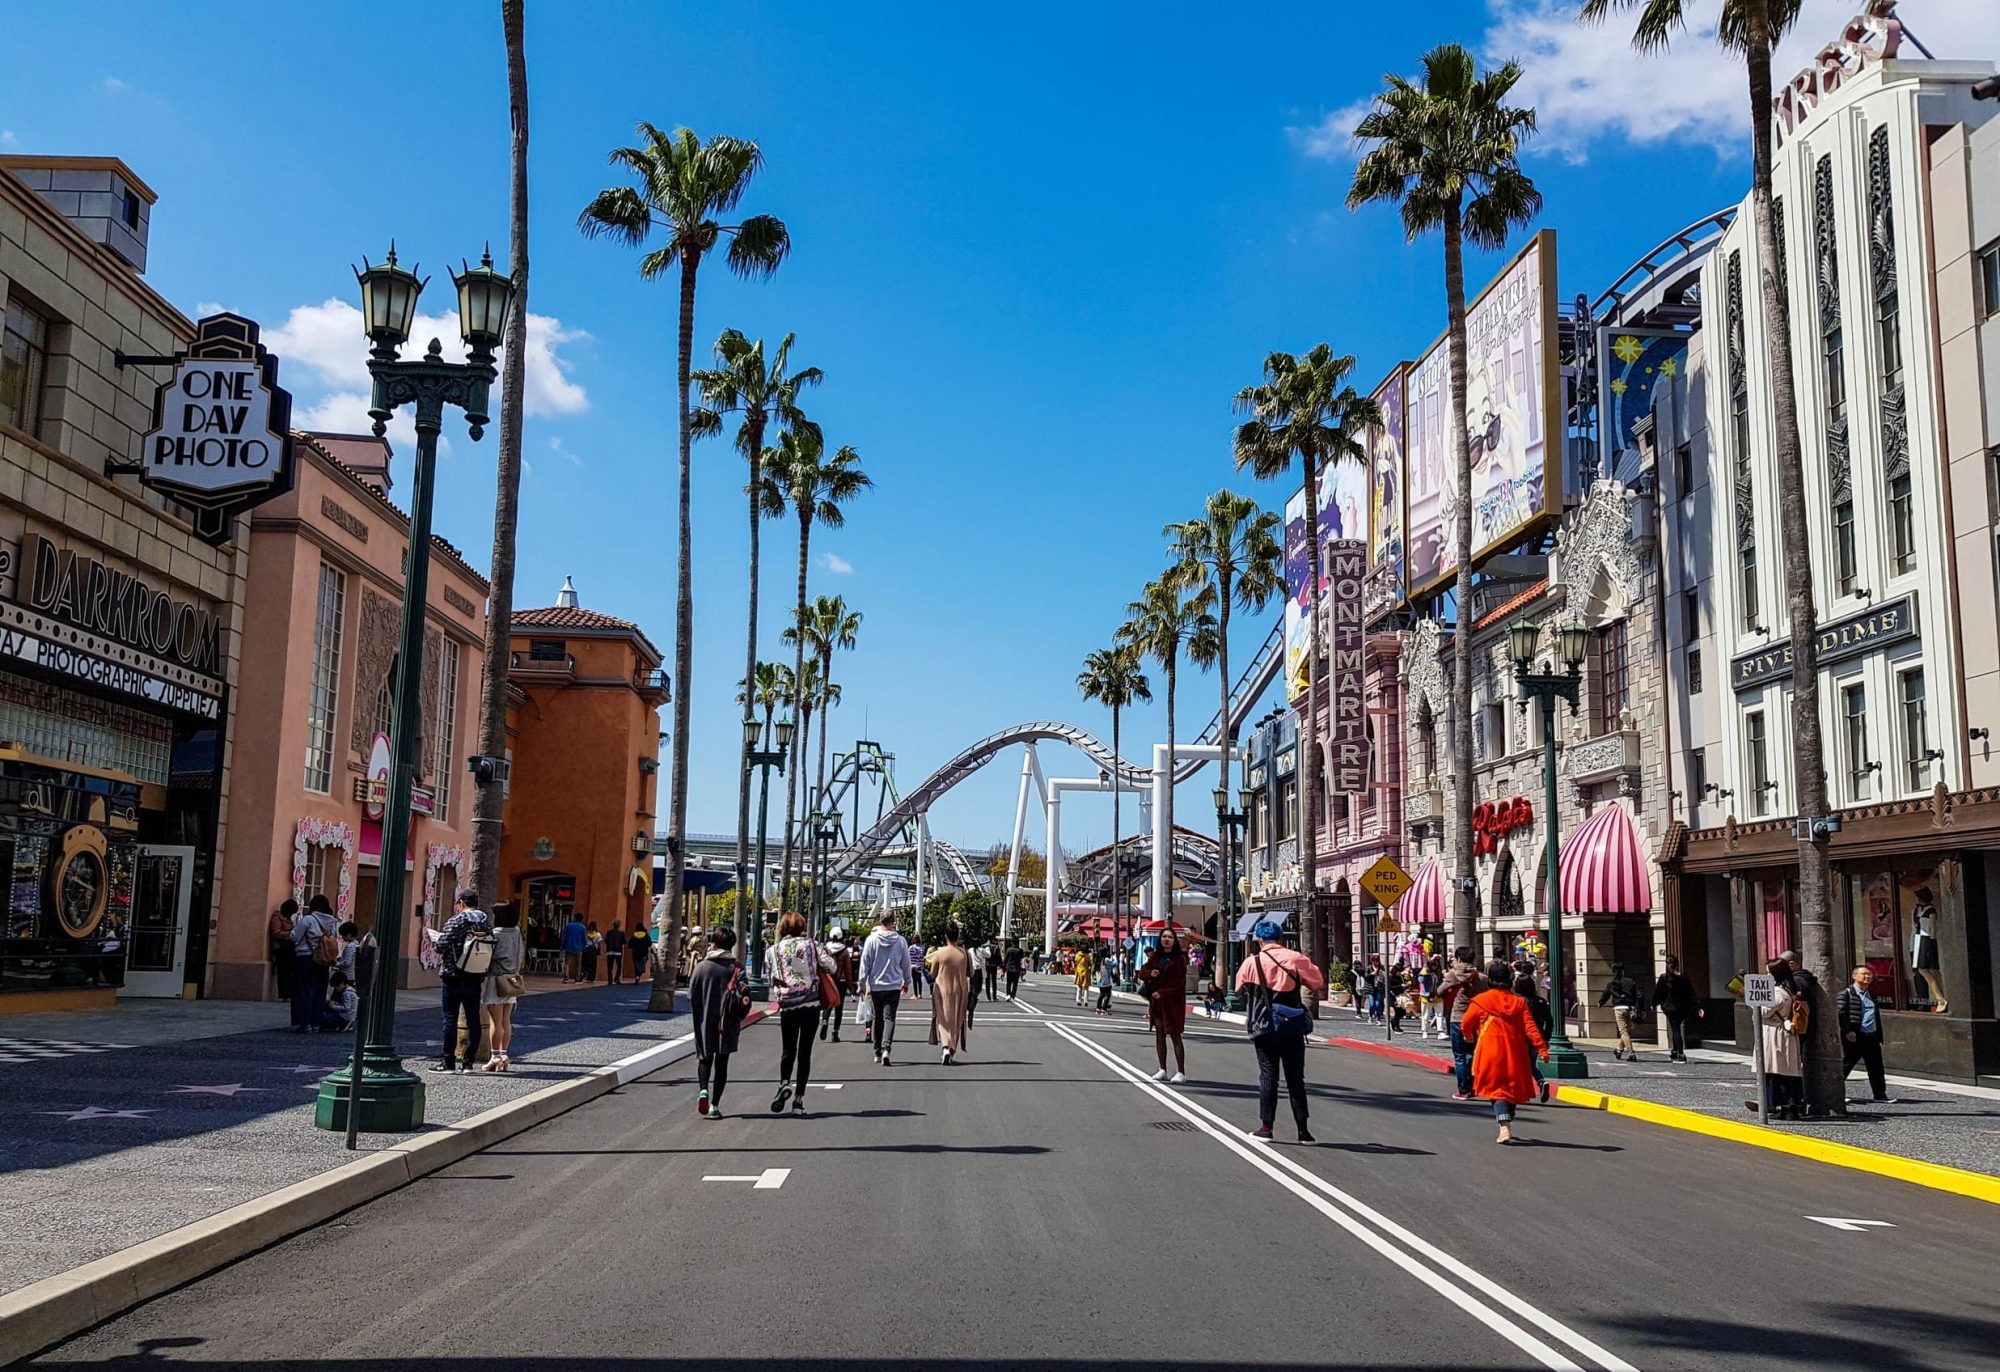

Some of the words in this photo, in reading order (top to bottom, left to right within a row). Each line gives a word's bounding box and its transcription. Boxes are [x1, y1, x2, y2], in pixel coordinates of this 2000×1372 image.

[1419, 348, 1450, 399] SHOPP
[1468, 270, 1527, 351] PLEASURE
[182, 370, 254, 400] ONE
[182, 404, 249, 434] DAY
[154, 436, 269, 468] PHOTO
[30, 534, 221, 675] DARKROOM
[1820, 610, 1898, 654] DIME
[37, 640, 151, 698] PHOTOGRAPHIC
[159, 683, 214, 718] SUPPLIES
[1335, 556, 1364, 789] MONTMARTRE
[1374, 884, 1399, 893] XING
[1375, 871, 1397, 880] PED
[1749, 991, 1772, 1001] ZONE
[1750, 980, 1769, 990] TAXI
